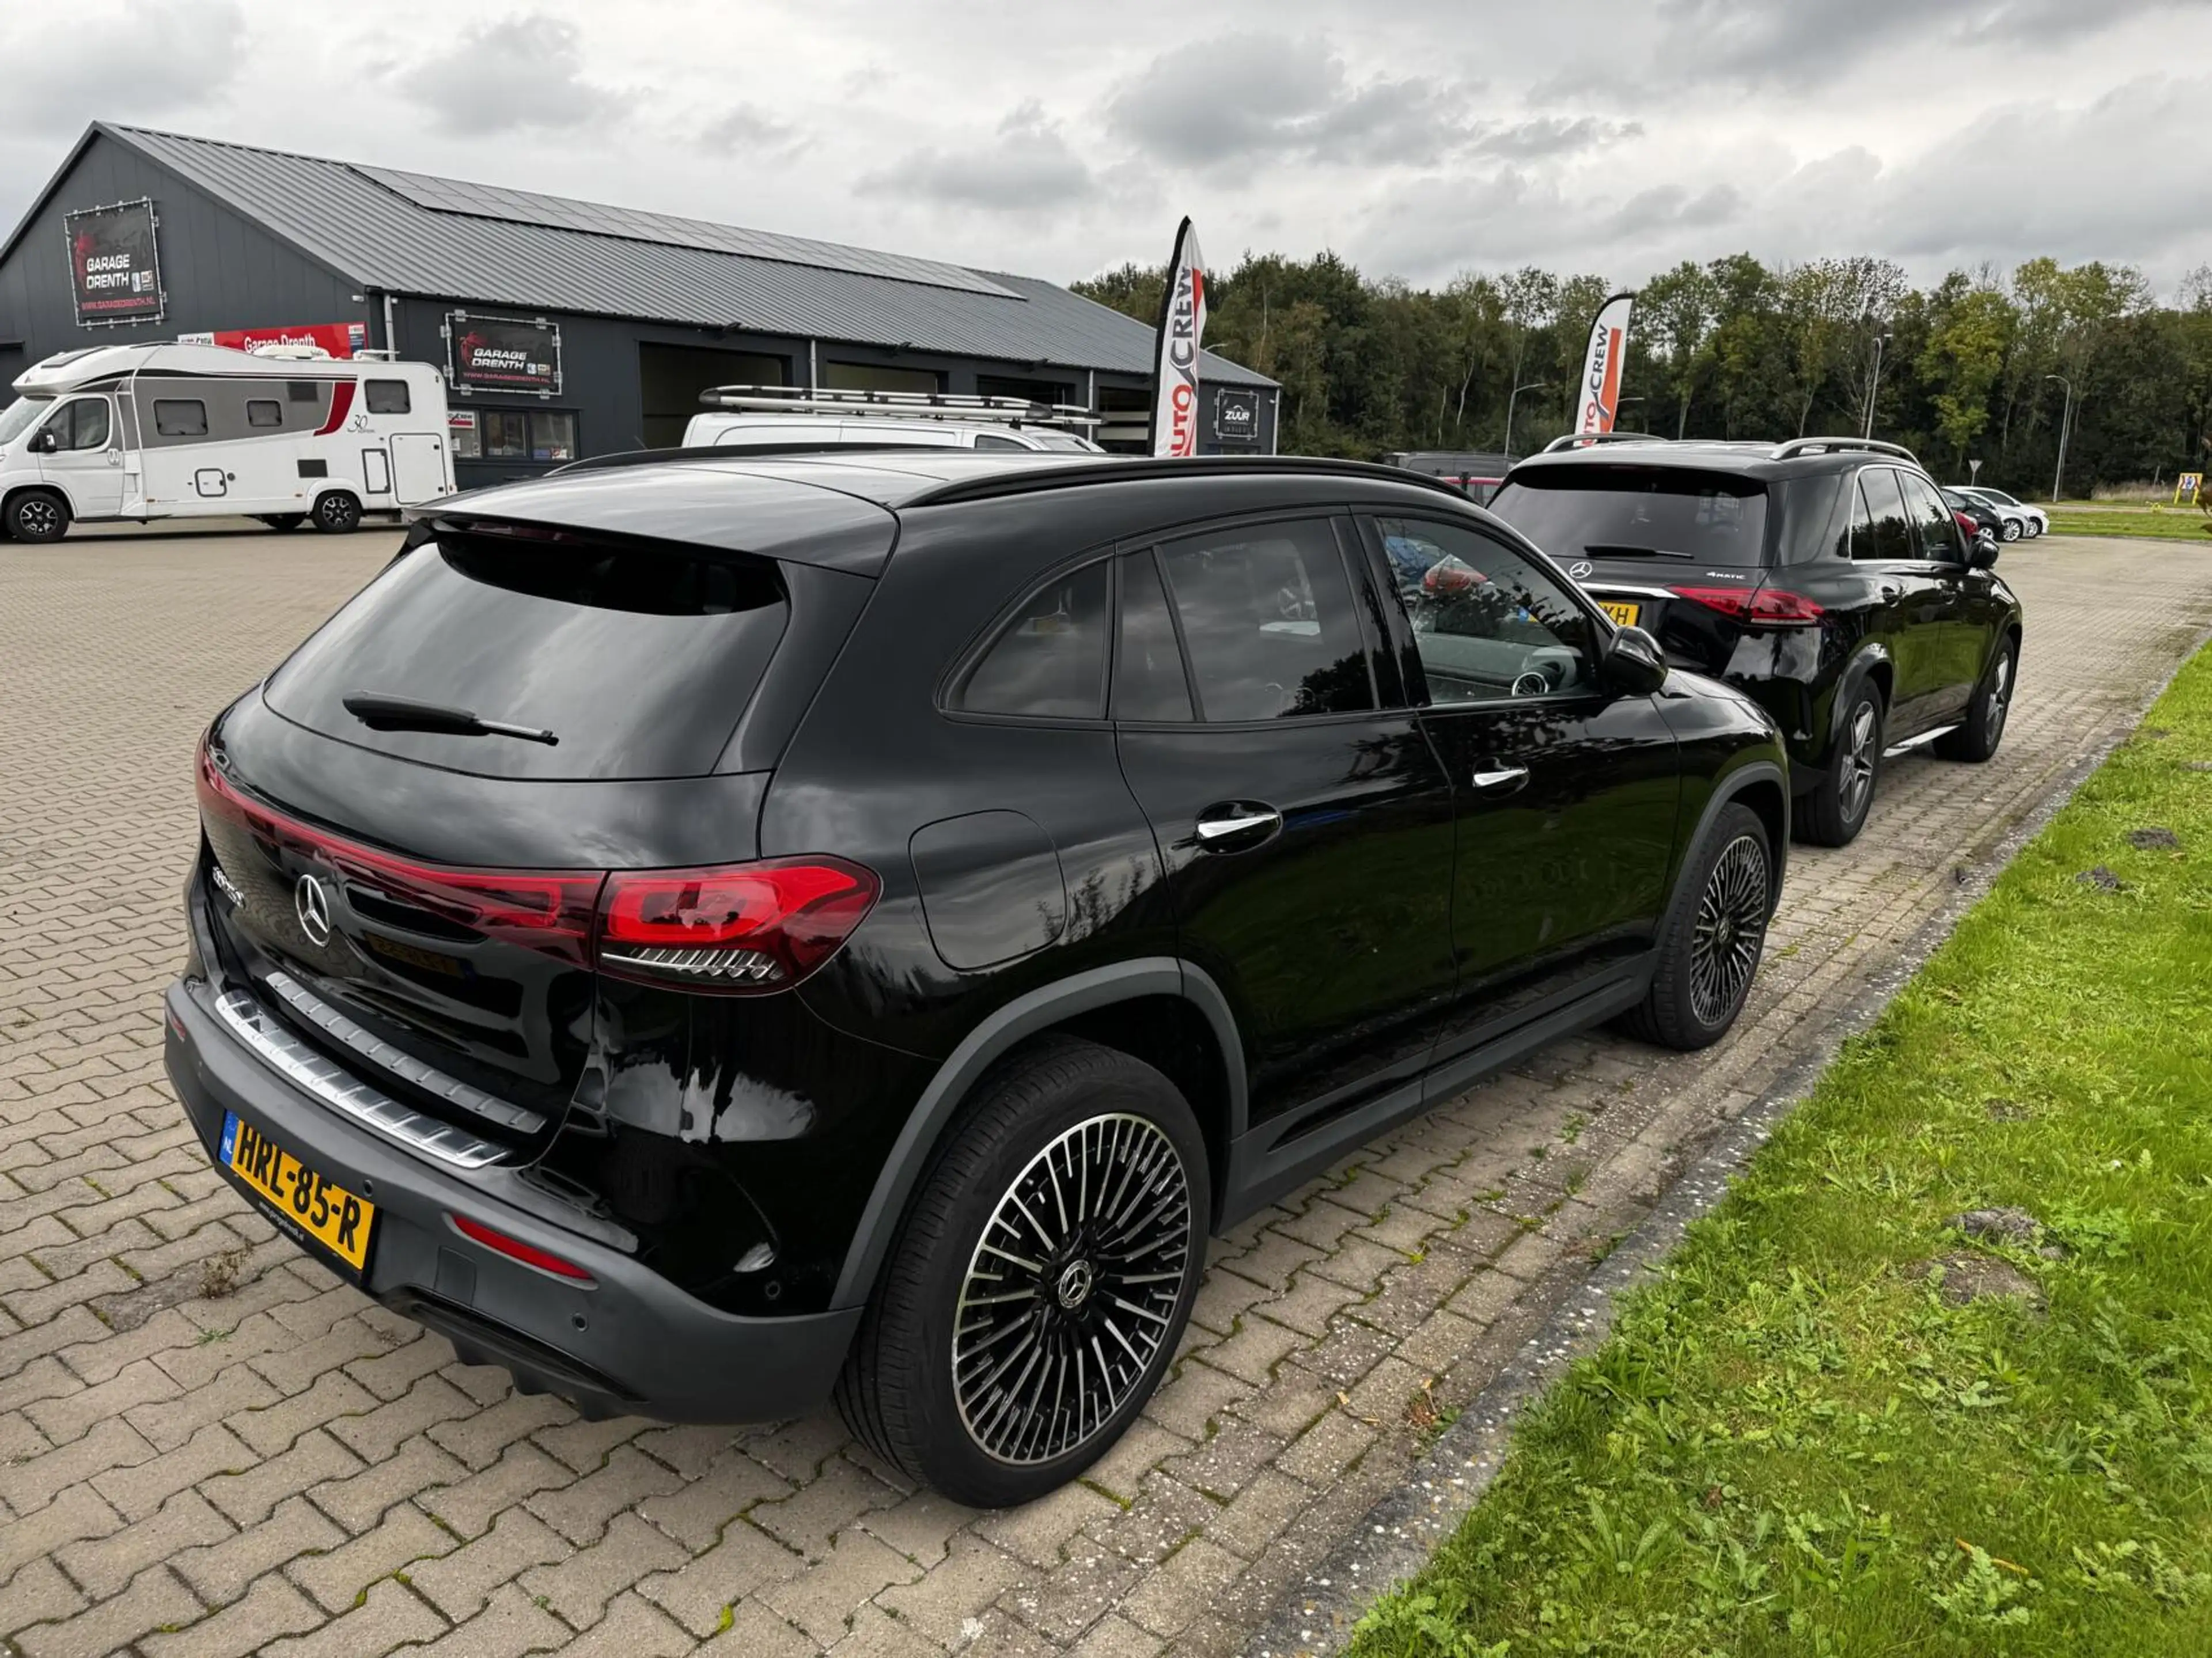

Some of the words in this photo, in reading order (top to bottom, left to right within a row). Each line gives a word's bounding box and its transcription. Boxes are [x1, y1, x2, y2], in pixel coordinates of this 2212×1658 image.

[87, 254, 130, 272] GARAGE
[86, 272, 129, 289] DRENTH
[474, 348, 527, 361] GARAGE
[472, 358, 525, 370] DRENTH
[223, 1136, 233, 1155] NL
[236, 1125, 361, 1254] HRL-85-R
